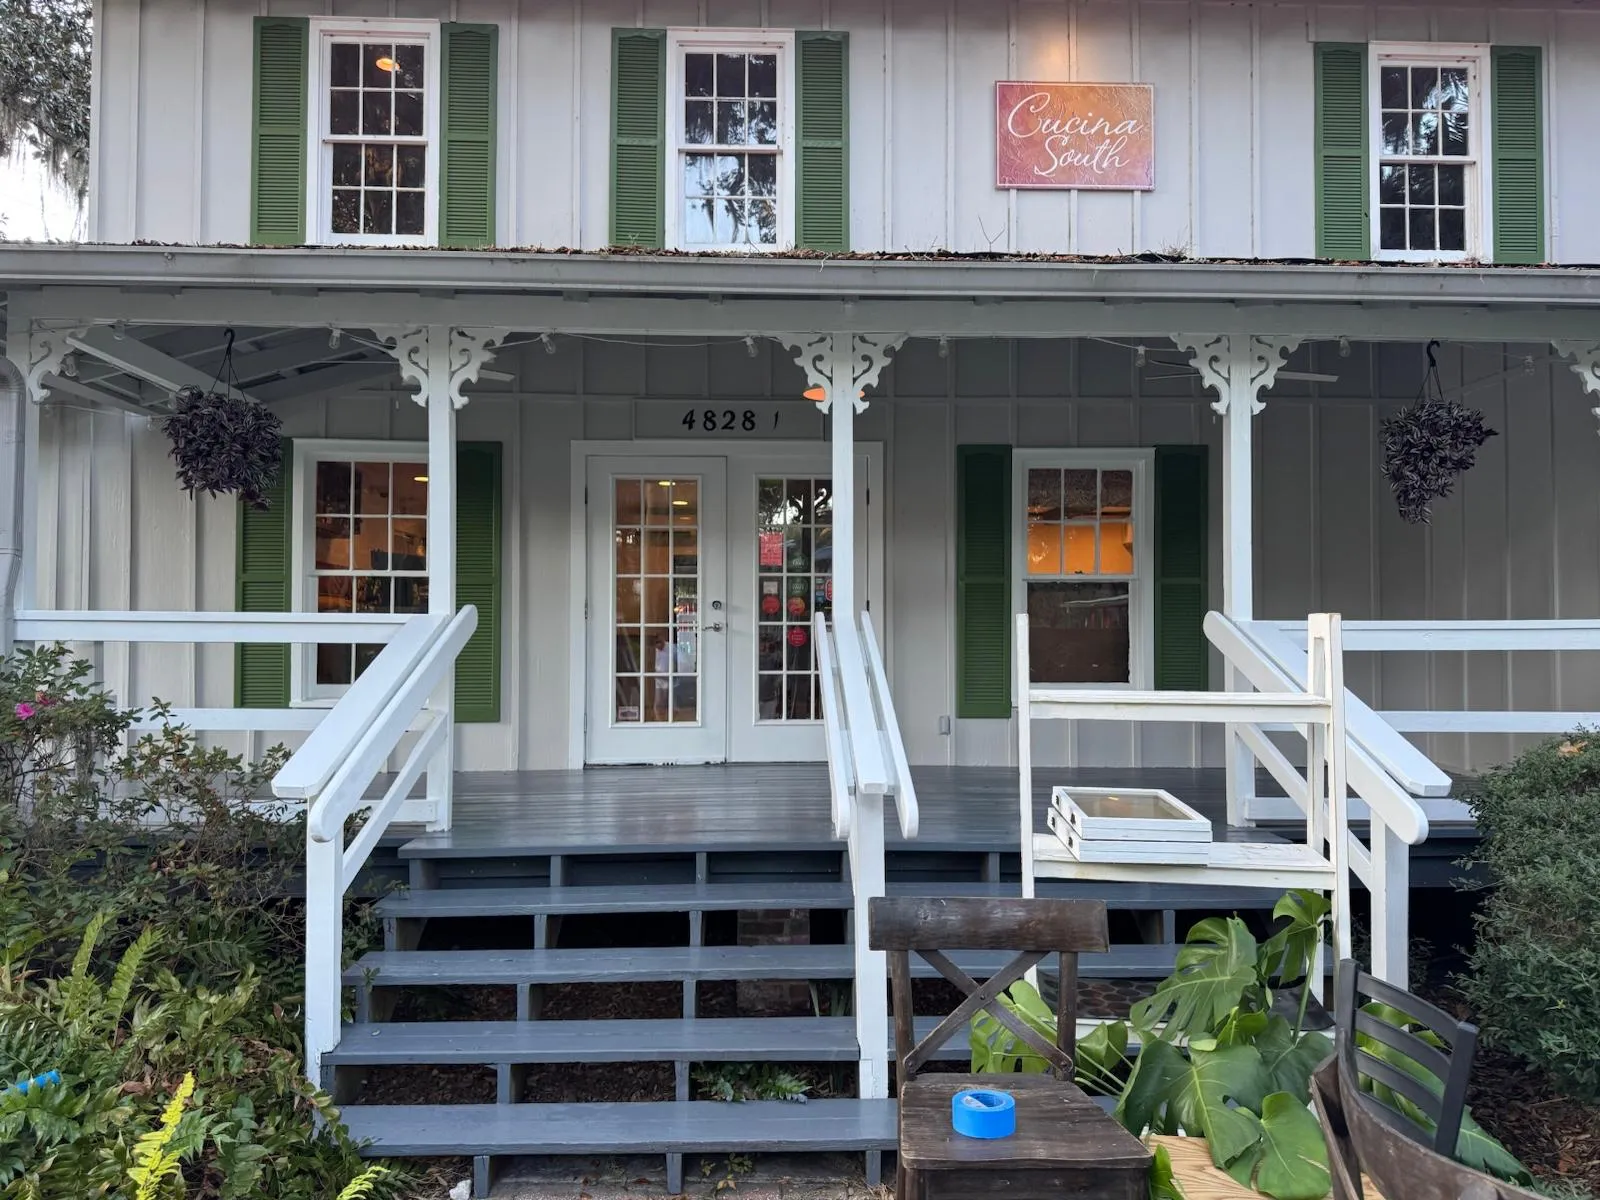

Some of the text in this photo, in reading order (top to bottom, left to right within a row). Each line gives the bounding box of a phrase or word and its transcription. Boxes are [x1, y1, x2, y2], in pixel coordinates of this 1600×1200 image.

[1008, 92, 1142, 138] Cucina
[1034, 135, 1129, 177] South
[682, 409, 756, 431] 4828
